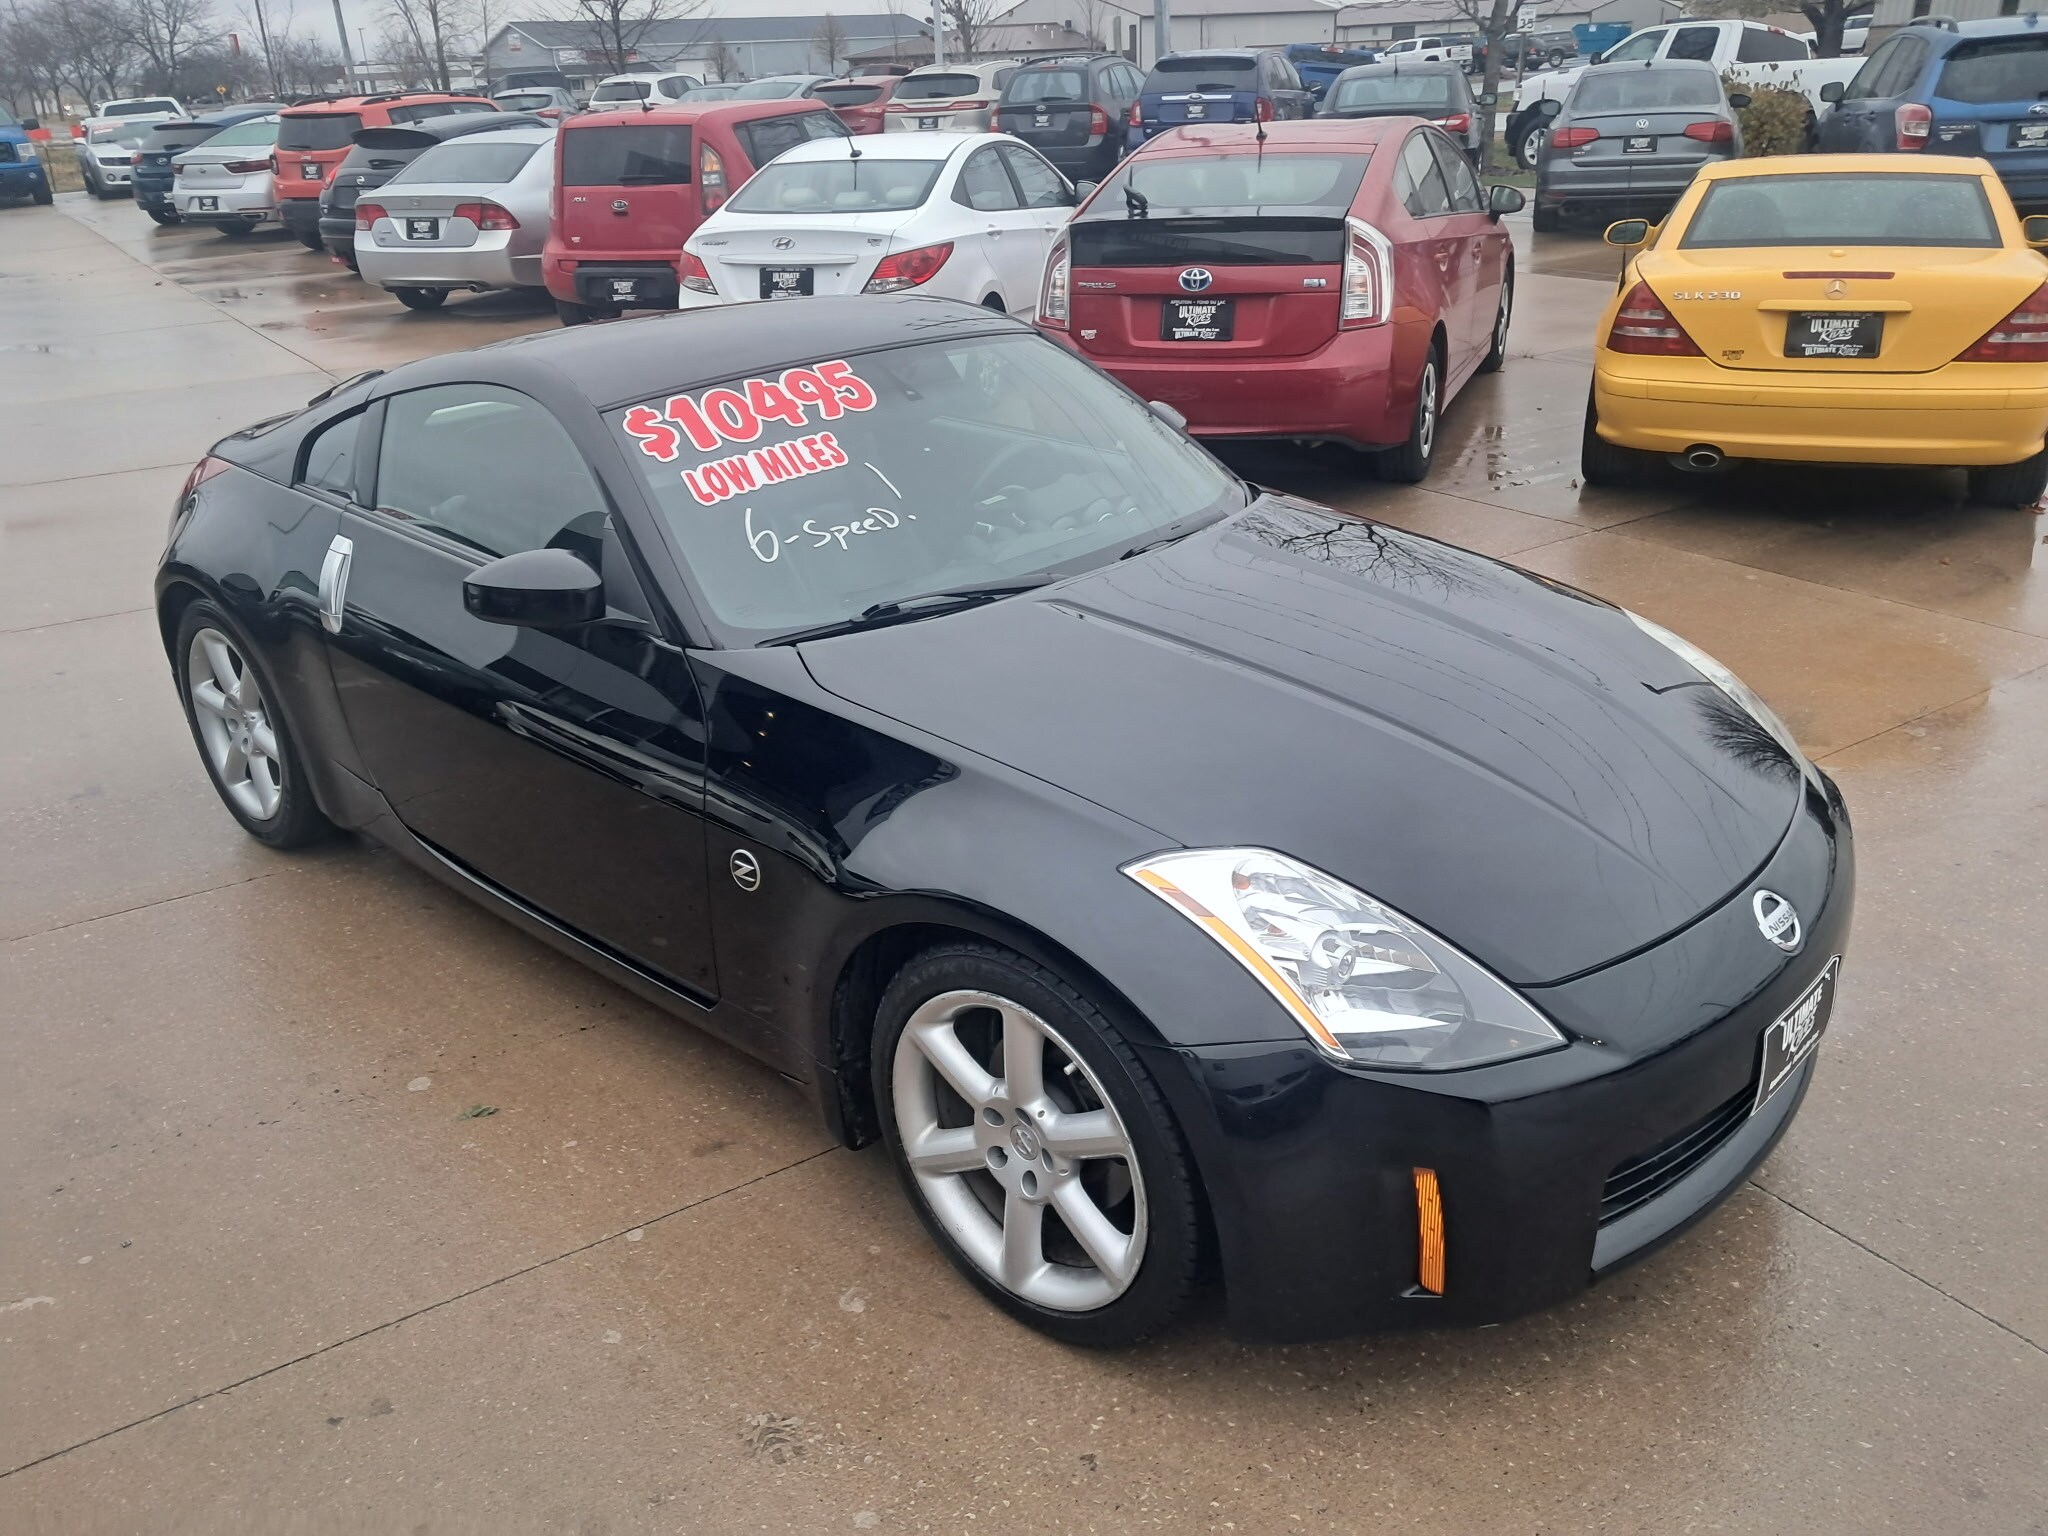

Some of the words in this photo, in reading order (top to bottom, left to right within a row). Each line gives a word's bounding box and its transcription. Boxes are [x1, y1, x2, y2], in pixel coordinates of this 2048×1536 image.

[772, 272, 800, 282] ULTIMATE
[1674, 291, 1704, 300] SLK
[1708, 291, 1741, 300] 230
[1179, 305, 1216, 318] ULTIMATE
[1810, 319, 1860, 333] ULTIMATE
[624, 360, 876, 462] $10495
[684, 456, 756, 504] LOW
[753, 431, 848, 482] MILES
[1779, 983, 1824, 1051] ULTIMATE
